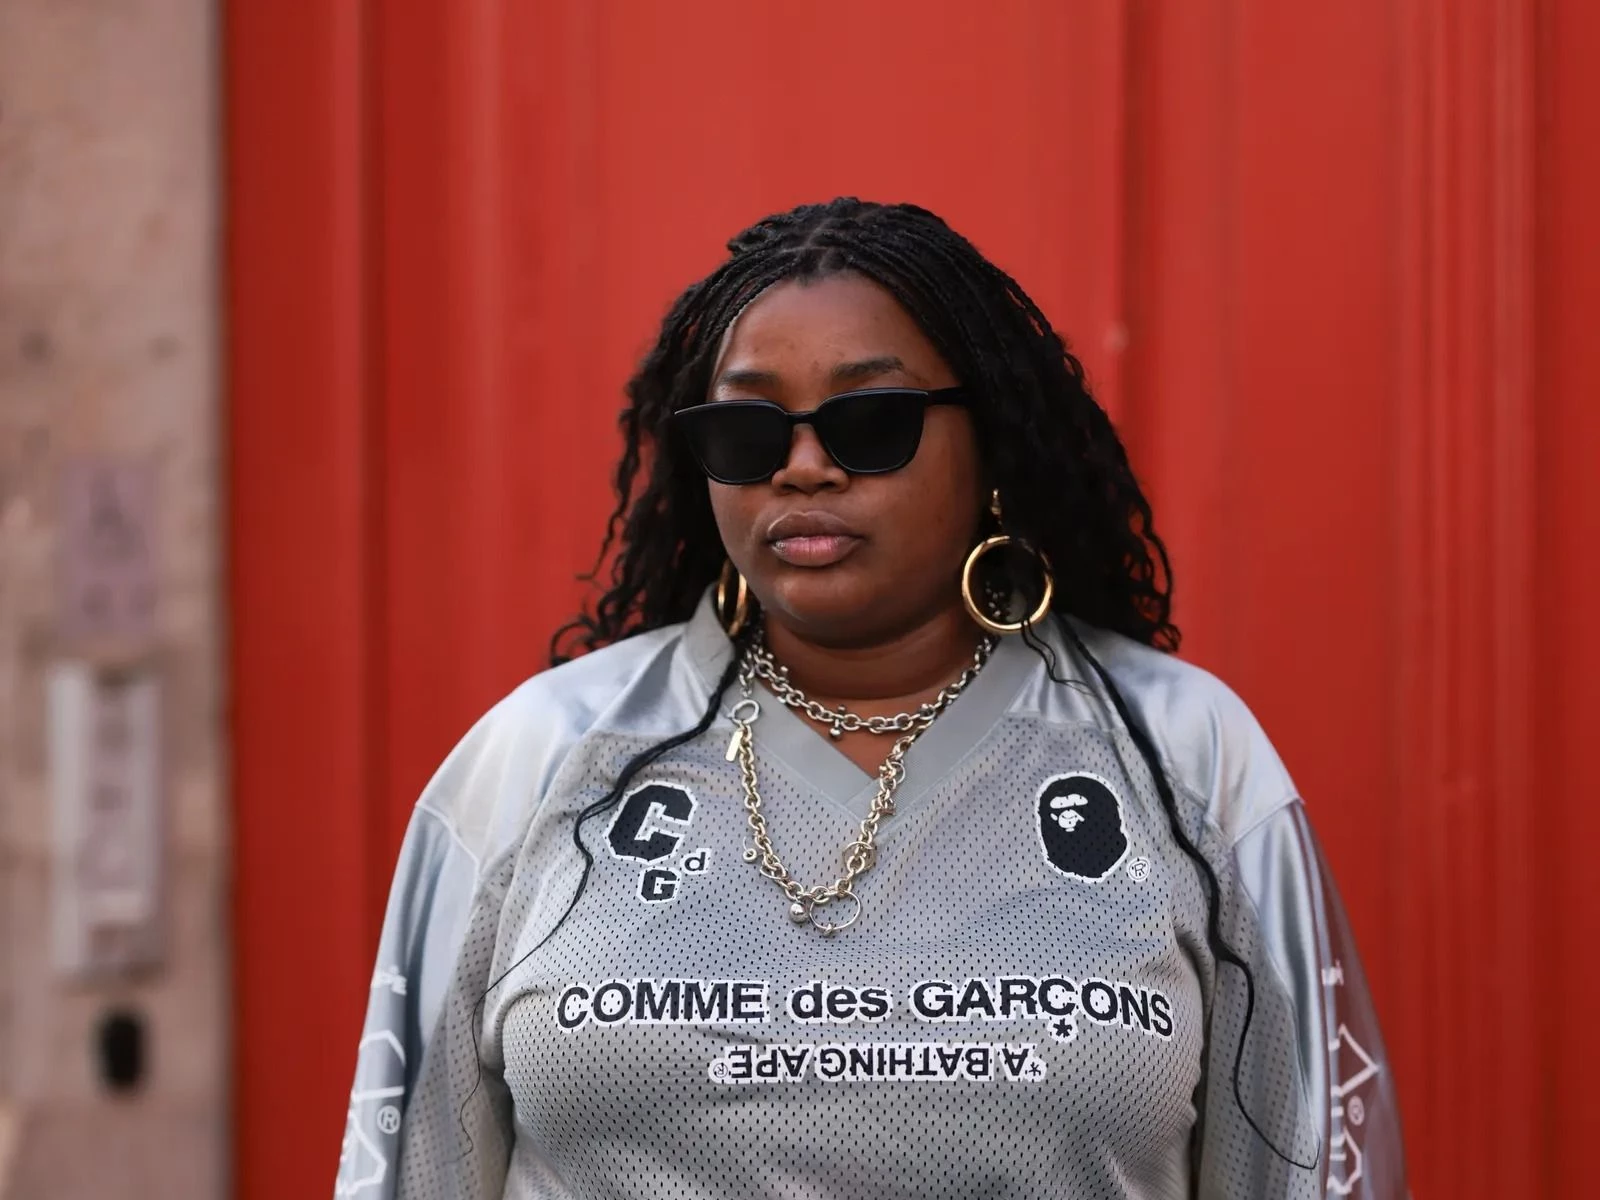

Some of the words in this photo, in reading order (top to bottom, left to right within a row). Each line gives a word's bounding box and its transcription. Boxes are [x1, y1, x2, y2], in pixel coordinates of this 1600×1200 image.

[608, 784, 694, 862] C
[640, 868, 678, 901] G
[557, 981, 765, 1029] COMME
[789, 982, 888, 1019] des
[820, 1047, 989, 1077] BATHING
